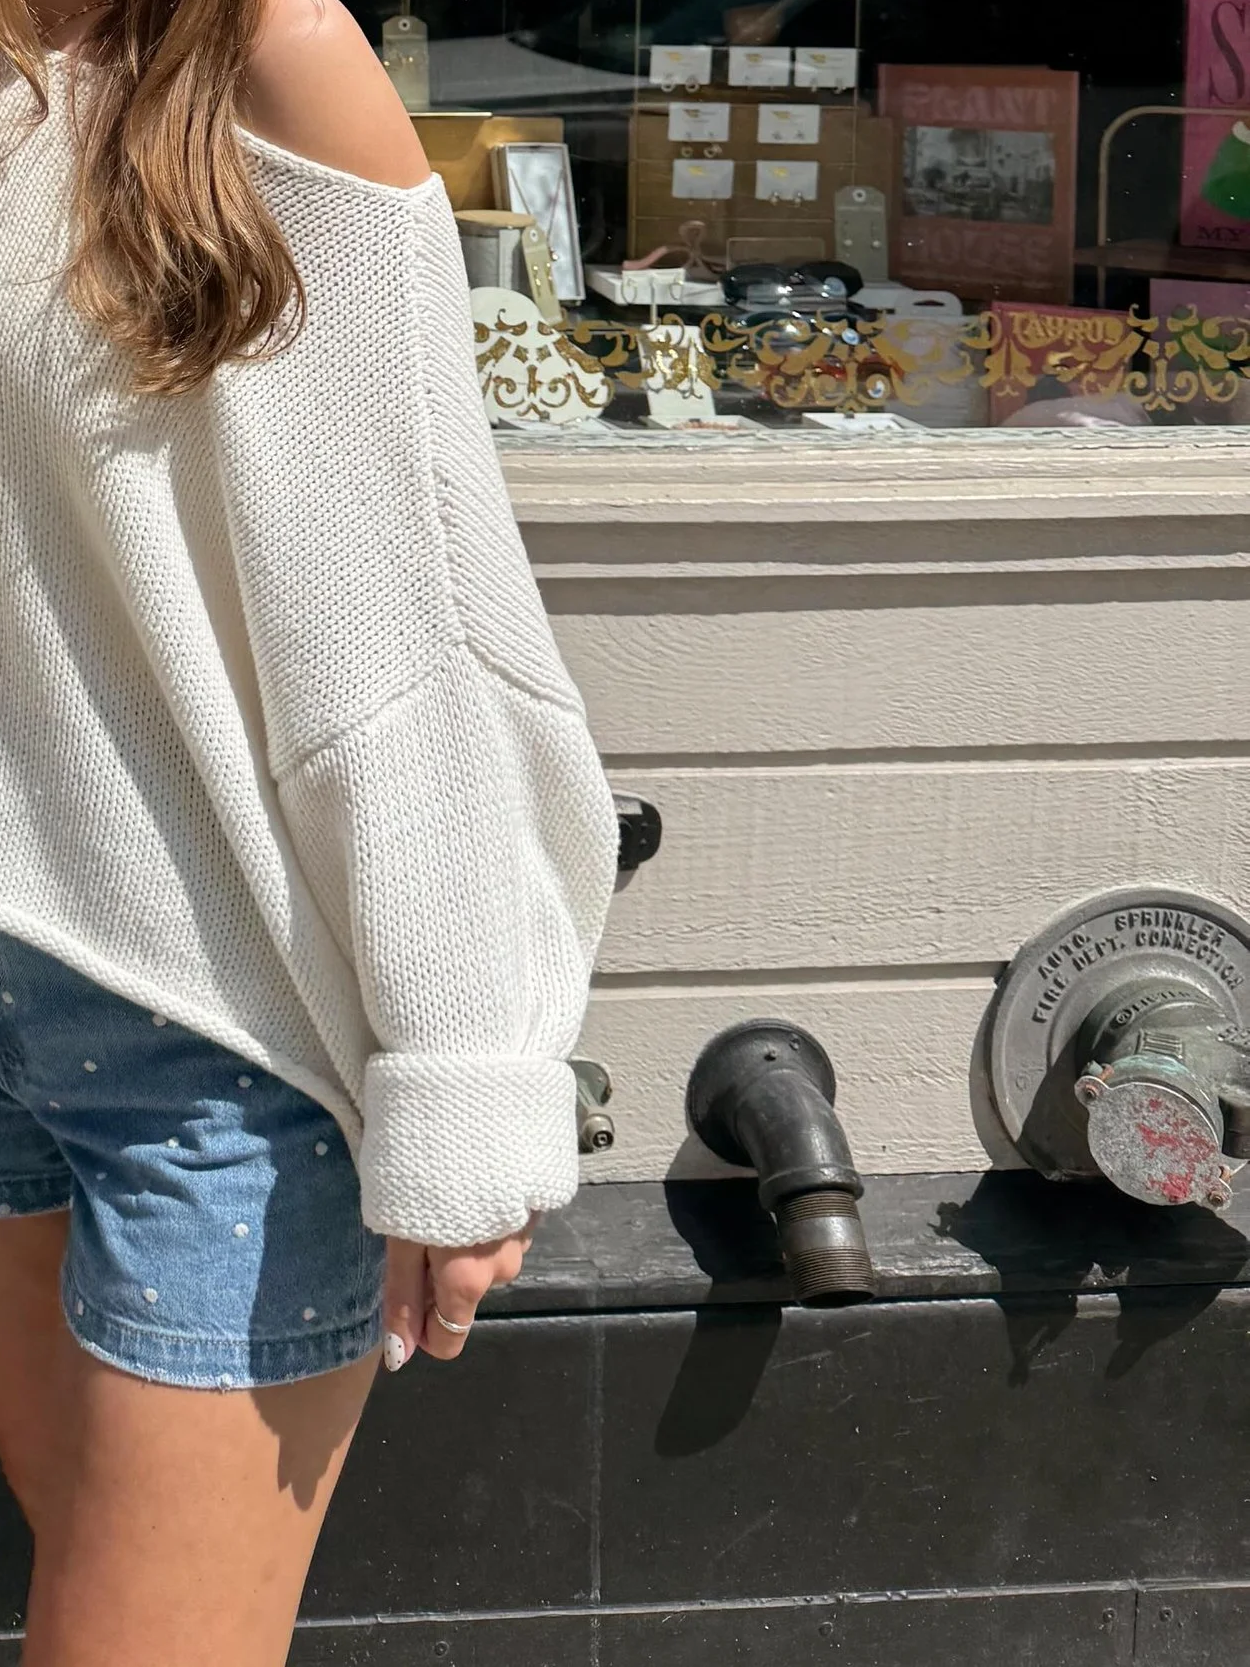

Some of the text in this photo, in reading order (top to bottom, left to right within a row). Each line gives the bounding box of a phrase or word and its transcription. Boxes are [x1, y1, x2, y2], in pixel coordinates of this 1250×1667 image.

[1008, 311, 1122, 346] TAURU
[1114, 910, 1227, 948] SPRINKLER
[1031, 976, 1069, 1024] FIRE
[1135, 928, 1245, 990] CONNECTION
